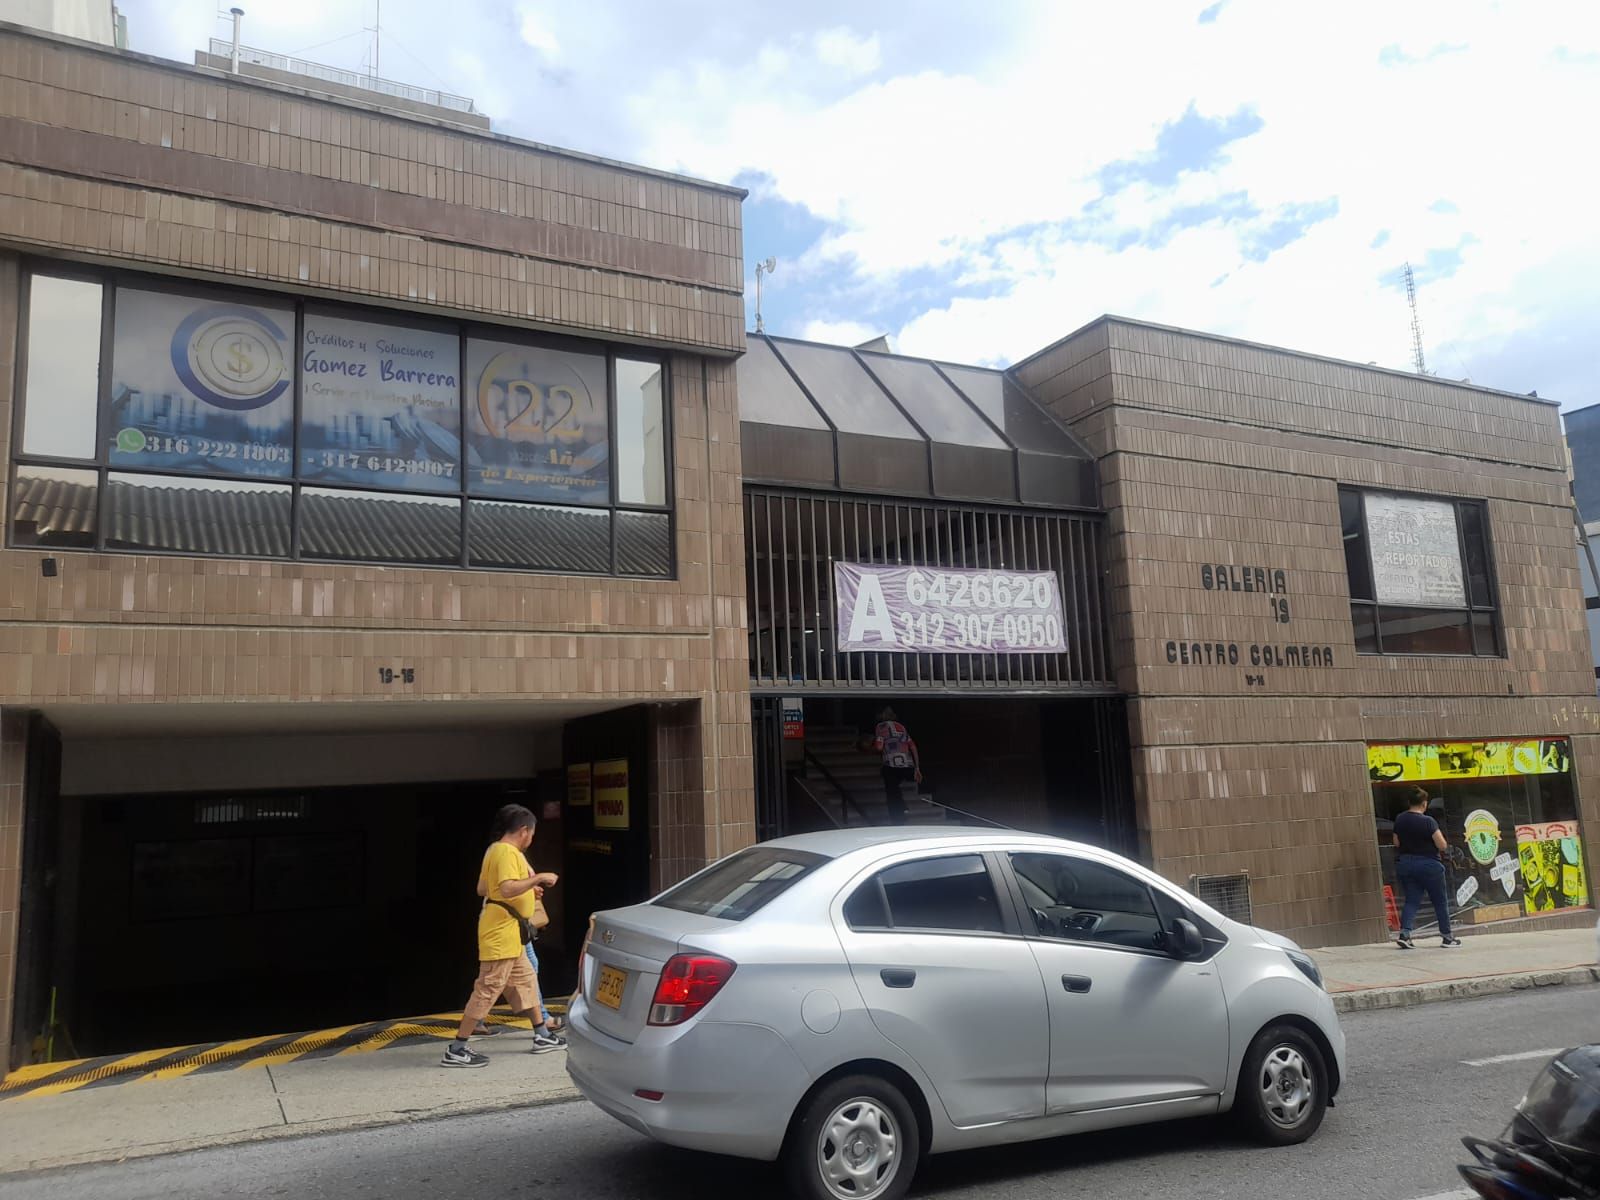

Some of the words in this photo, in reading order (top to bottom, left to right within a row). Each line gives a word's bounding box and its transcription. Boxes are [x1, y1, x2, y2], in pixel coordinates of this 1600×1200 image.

[376, 339, 435, 359] Soluciones
[304, 350, 368, 377] Gomez
[380, 359, 456, 387] Barrera
[148, 436, 190, 455] 316
[197, 438, 238, 458] 222
[322, 452, 360, 469] 317
[905, 572, 1051, 609] 6426620
[1201, 564, 1287, 594] GALERIA
[847, 574, 898, 642] A
[1270, 597, 1290, 624] 19
[900, 612, 946, 647] 312
[953, 613, 995, 647] 307
[1003, 614, 1059, 647] 0950
[1166, 640, 1239, 666] CENTRO
[1250, 644, 1334, 667] COLMENA
